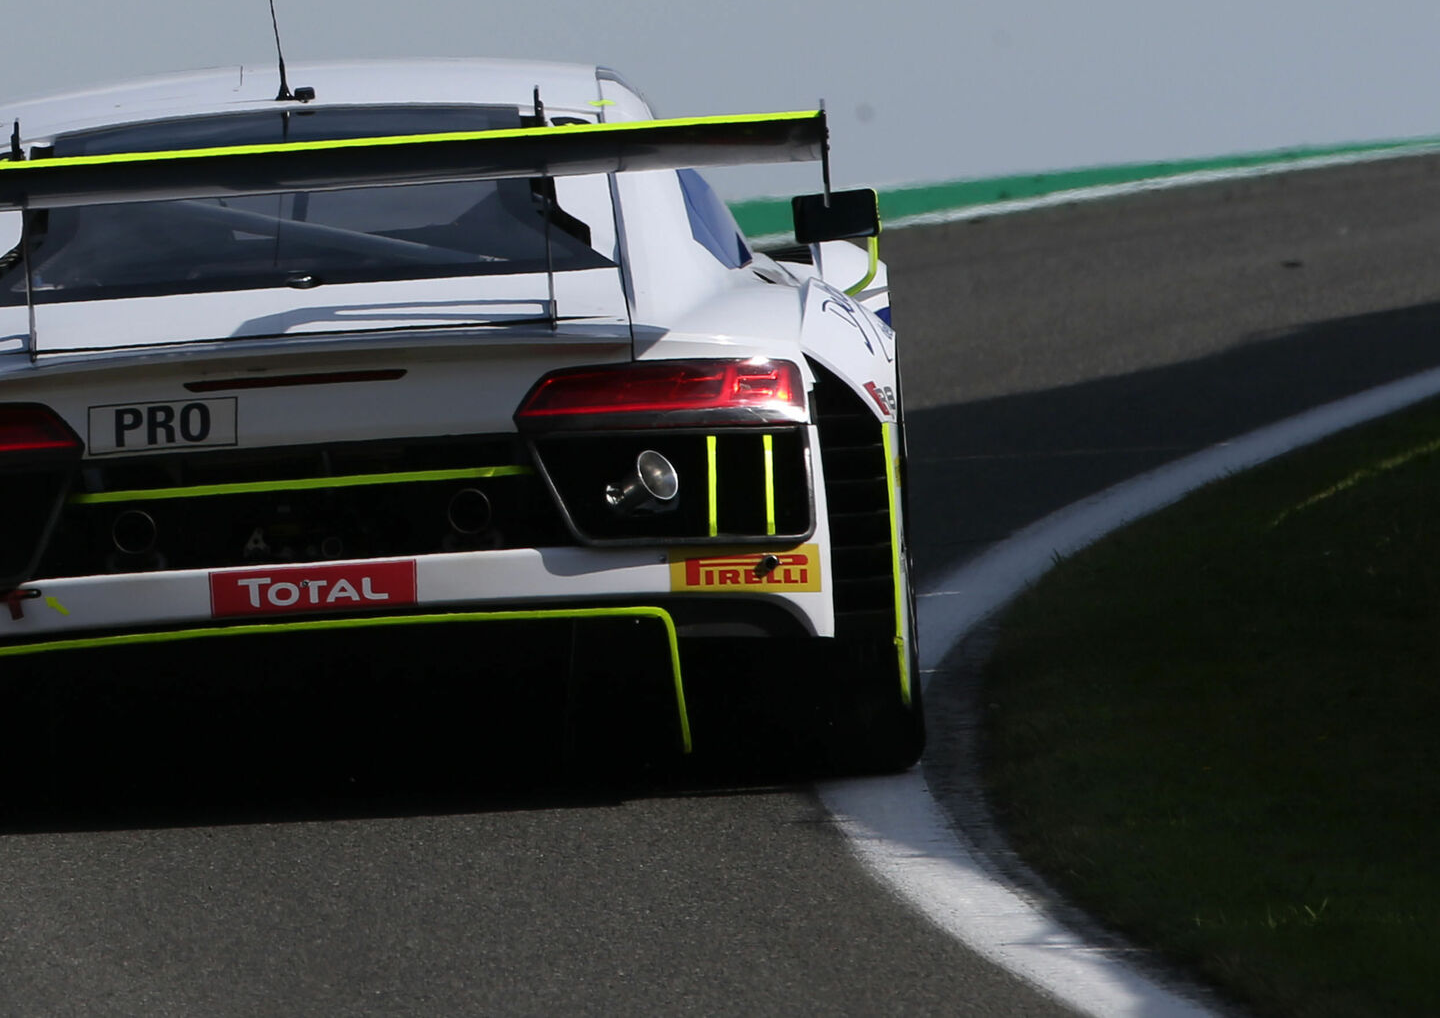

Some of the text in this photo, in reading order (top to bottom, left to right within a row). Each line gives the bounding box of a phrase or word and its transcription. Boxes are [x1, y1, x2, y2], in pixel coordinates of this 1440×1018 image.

[114, 402, 210, 448] PRO
[685, 553, 809, 586] PIRELLI
[237, 576, 389, 608] TOTAL
